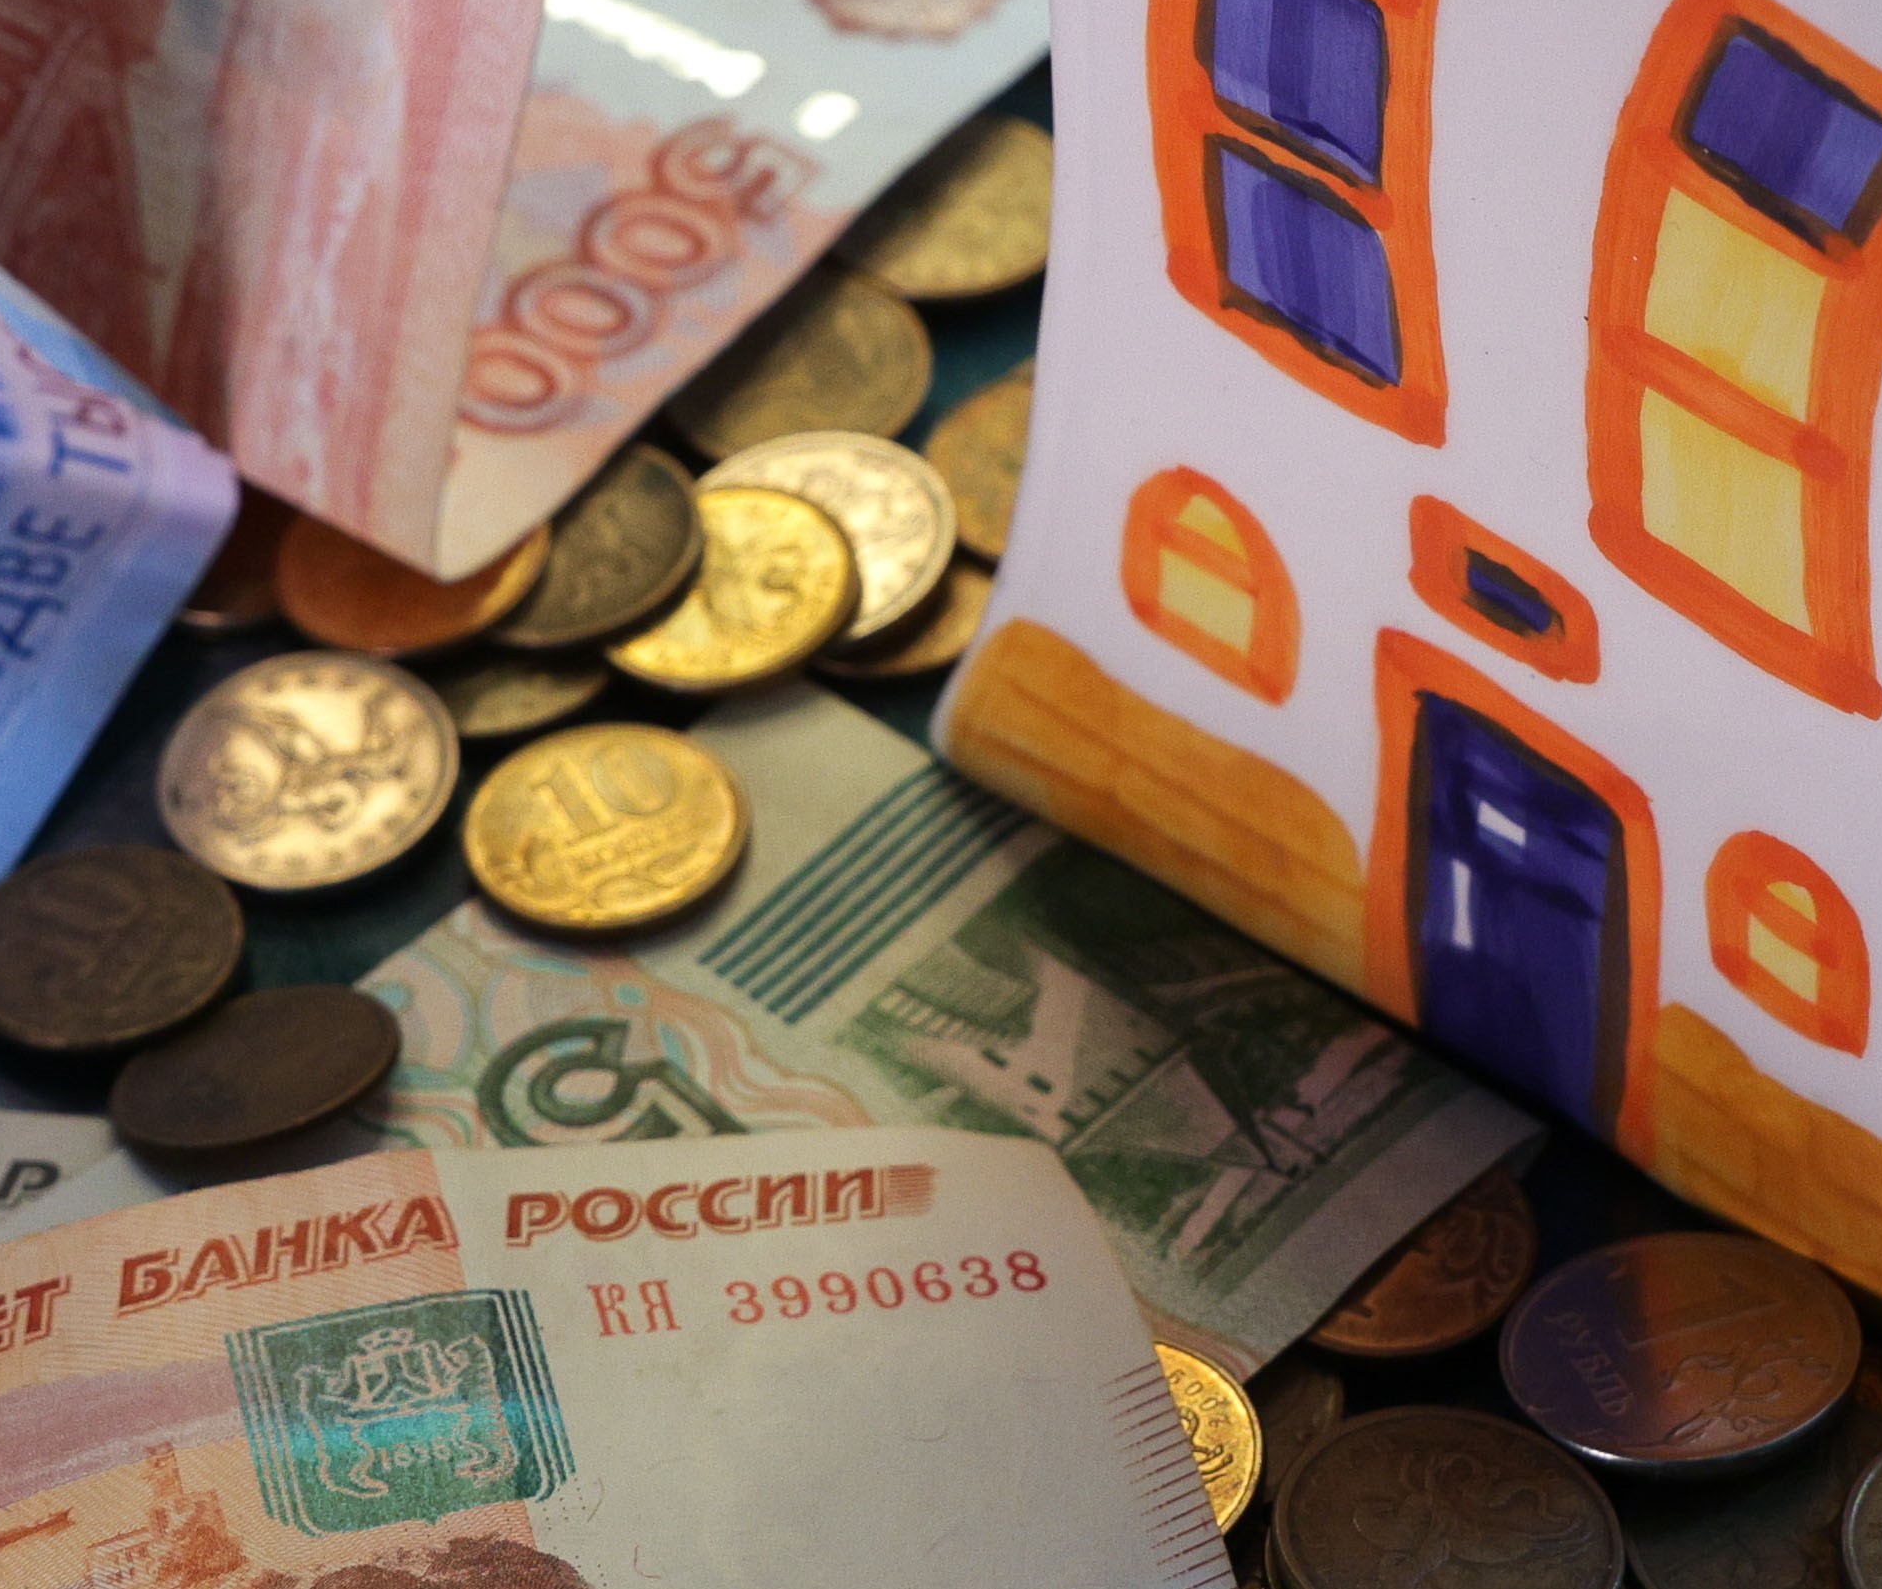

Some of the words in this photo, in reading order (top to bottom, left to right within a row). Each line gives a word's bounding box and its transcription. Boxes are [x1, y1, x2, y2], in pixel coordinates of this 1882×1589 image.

[460, 110, 823, 436] 5000
[532, 743, 680, 845] 10
[117, 1197, 461, 1318] БАНКА
[505, 1166, 885, 1248] РОССИИ
[587, 1279, 682, 1338] КЯ
[725, 1249, 1048, 1325] 3990638
[1543, 1308, 1635, 1419] РУБЛЬ
